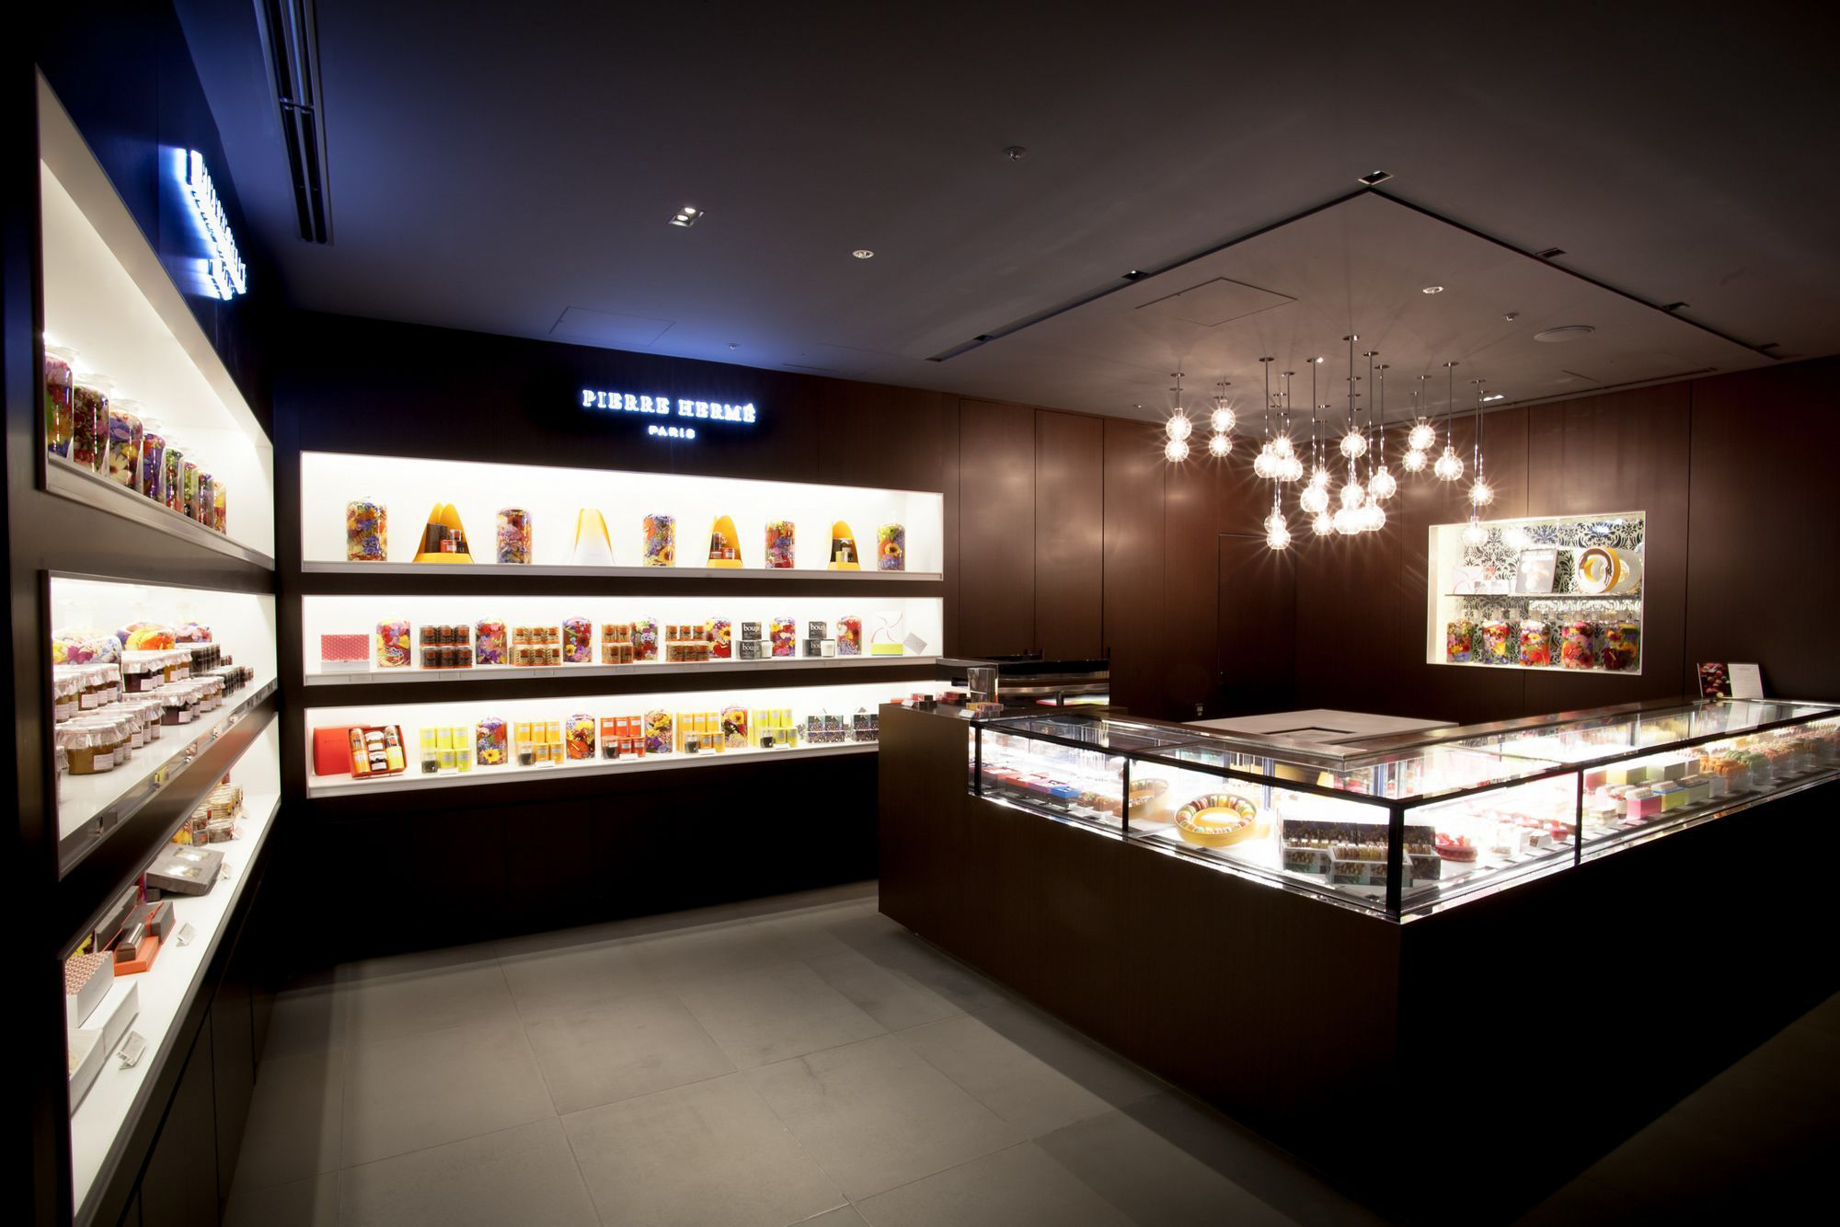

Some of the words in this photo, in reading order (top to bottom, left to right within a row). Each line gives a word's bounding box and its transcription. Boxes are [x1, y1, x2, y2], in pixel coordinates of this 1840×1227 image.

[582, 389, 670, 414] PIERRE
[677, 398, 756, 423] HERMÉ
[648, 425, 696, 439] PARIS
